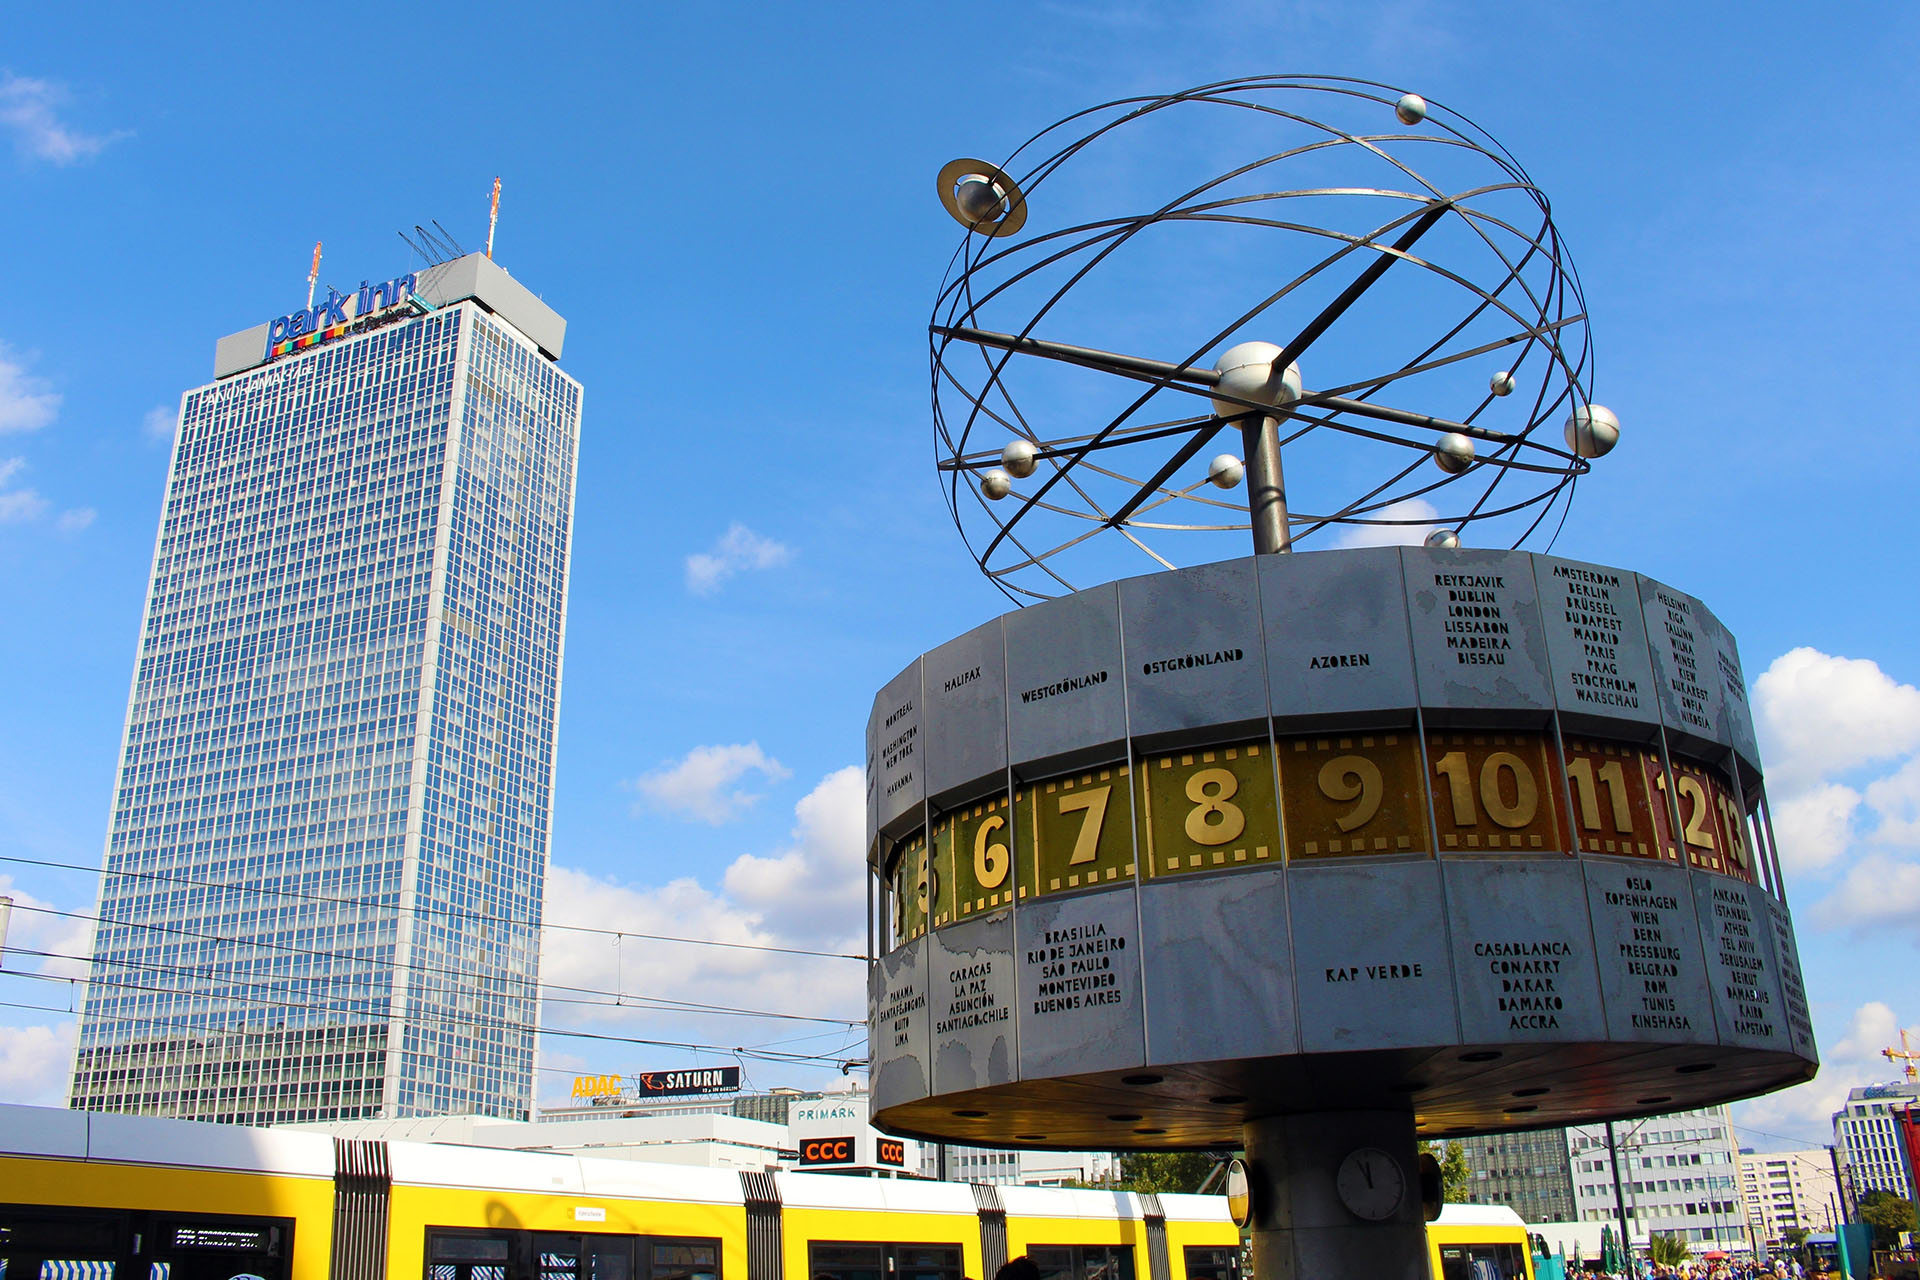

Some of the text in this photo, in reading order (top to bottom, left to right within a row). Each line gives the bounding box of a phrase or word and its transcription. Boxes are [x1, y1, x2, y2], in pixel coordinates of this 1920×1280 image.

[265, 273, 416, 359] park inn
[1434, 574, 1505, 588] REYKJAVIK
[1553, 565, 1620, 588] AMSTERDAM
[1448, 590, 1496, 603] DUBLIN
[1568, 583, 1610, 600] BERLIN
[1448, 605, 1500, 619] LONDON
[1566, 596, 1618, 616] BRÜSSEL
[1657, 592, 1690, 616] HELSINKI
[1565, 611, 1622, 632] BUDAPEST
[1667, 610, 1685, 626] RIGA
[1444, 621, 1509, 634] LISSABON
[1573, 627, 1619, 645] MADRID
[1664, 621, 1694, 643] TALLINN
[1447, 636, 1511, 650] MADEIRA
[1584, 644, 1616, 660] PARIS
[1669, 637, 1695, 656] WILNA
[1143, 648, 1243, 675] OSTGRÖNLAND
[1310, 653, 1370, 669] AZOREN
[1457, 652, 1505, 665] BISSAU
[1587, 660, 1617, 675] PRAG
[1672, 652, 1697, 670] MINSK
[944, 666, 981, 692] HALIFAX
[1571, 672, 1638, 694] STOCKHOLM
[1678, 667, 1696, 683] KIEW
[1021, 670, 1108, 703] WESTGRÖNLAND
[1671, 678, 1709, 702] BUKAREST
[1576, 688, 1639, 709] WARSCHAU
[1681, 696, 1705, 714] SOFIA
[885, 700, 913, 730] MONTREAL
[1680, 709, 1712, 730] NIKOSIA
[882, 724, 918, 760] WASHINGTON
[886, 753, 898, 771] NEW
[899, 742, 914, 762] YORK
[1317, 754, 1384, 833] 9
[1435, 751, 1539, 829] 10
[1567, 757, 1633, 833] 11
[1185, 768, 1246, 846] 8
[1656, 770, 1714, 850] 12
[1058, 785, 1112, 866] 7
[1718, 791, 1747, 870] 13
[974, 815, 1009, 889] 6
[917, 845, 937, 914] 5
[1626, 877, 1652, 891] OSLO
[1605, 892, 1678, 910] KOPENHAGEN
[1713, 888, 1748, 906] ANKARA
[1630, 910, 1659, 925] WIEN
[1715, 904, 1752, 922] ISTANBUL
[1045, 923, 1106, 944] BRASILIA
[1633, 928, 1662, 942] BERN
[1723, 922, 1750, 937] ATHEN
[1028, 937, 1126, 964] RIO DE JANEIRO
[1474, 942, 1572, 957] CASABLANCA
[1619, 944, 1681, 961] PRESSBURG
[1721, 937, 1755, 954] TEL AVIV
[1071, 956, 1109, 974] PAULO
[1490, 961, 1560, 975] CONAKRY
[1628, 962, 1678, 977] BELGRAD
[1719, 952, 1764, 972] JERUSALEM
[949, 962, 991, 983] CARACAS
[1325, 964, 1423, 983] KAP VERDE
[1731, 971, 1758, 987] BEIRUT
[955, 979, 986, 998] LA PAZ
[1039, 973, 1115, 996] MONTEVIDEO
[1503, 979, 1555, 993] DAKAR
[1644, 980, 1668, 994] ROM
[949, 992, 994, 1015] ASUNCIÓN
[1034, 990, 1121, 1015] BUENOS AIRES
[1498, 996, 1563, 1011] BAMAKO
[1642, 998, 1676, 1012] TUNIS
[1739, 1004, 1763, 1019] KAIRO
[937, 1013, 979, 1034] SANTIAGO
[983, 1007, 1009, 1024] CHILE
[1510, 1015, 1559, 1029] ACCRA
[1631, 1014, 1691, 1030] KINSHASA
[1734, 1020, 1774, 1038] KAPSTADT
[571, 1074, 622, 1098] ADAC
[666, 1070, 723, 1089] SATURN
[799, 1107, 856, 1120] PRIMARK
[806, 1142, 847, 1160] CCC
[881, 1143, 902, 1162] CCC
